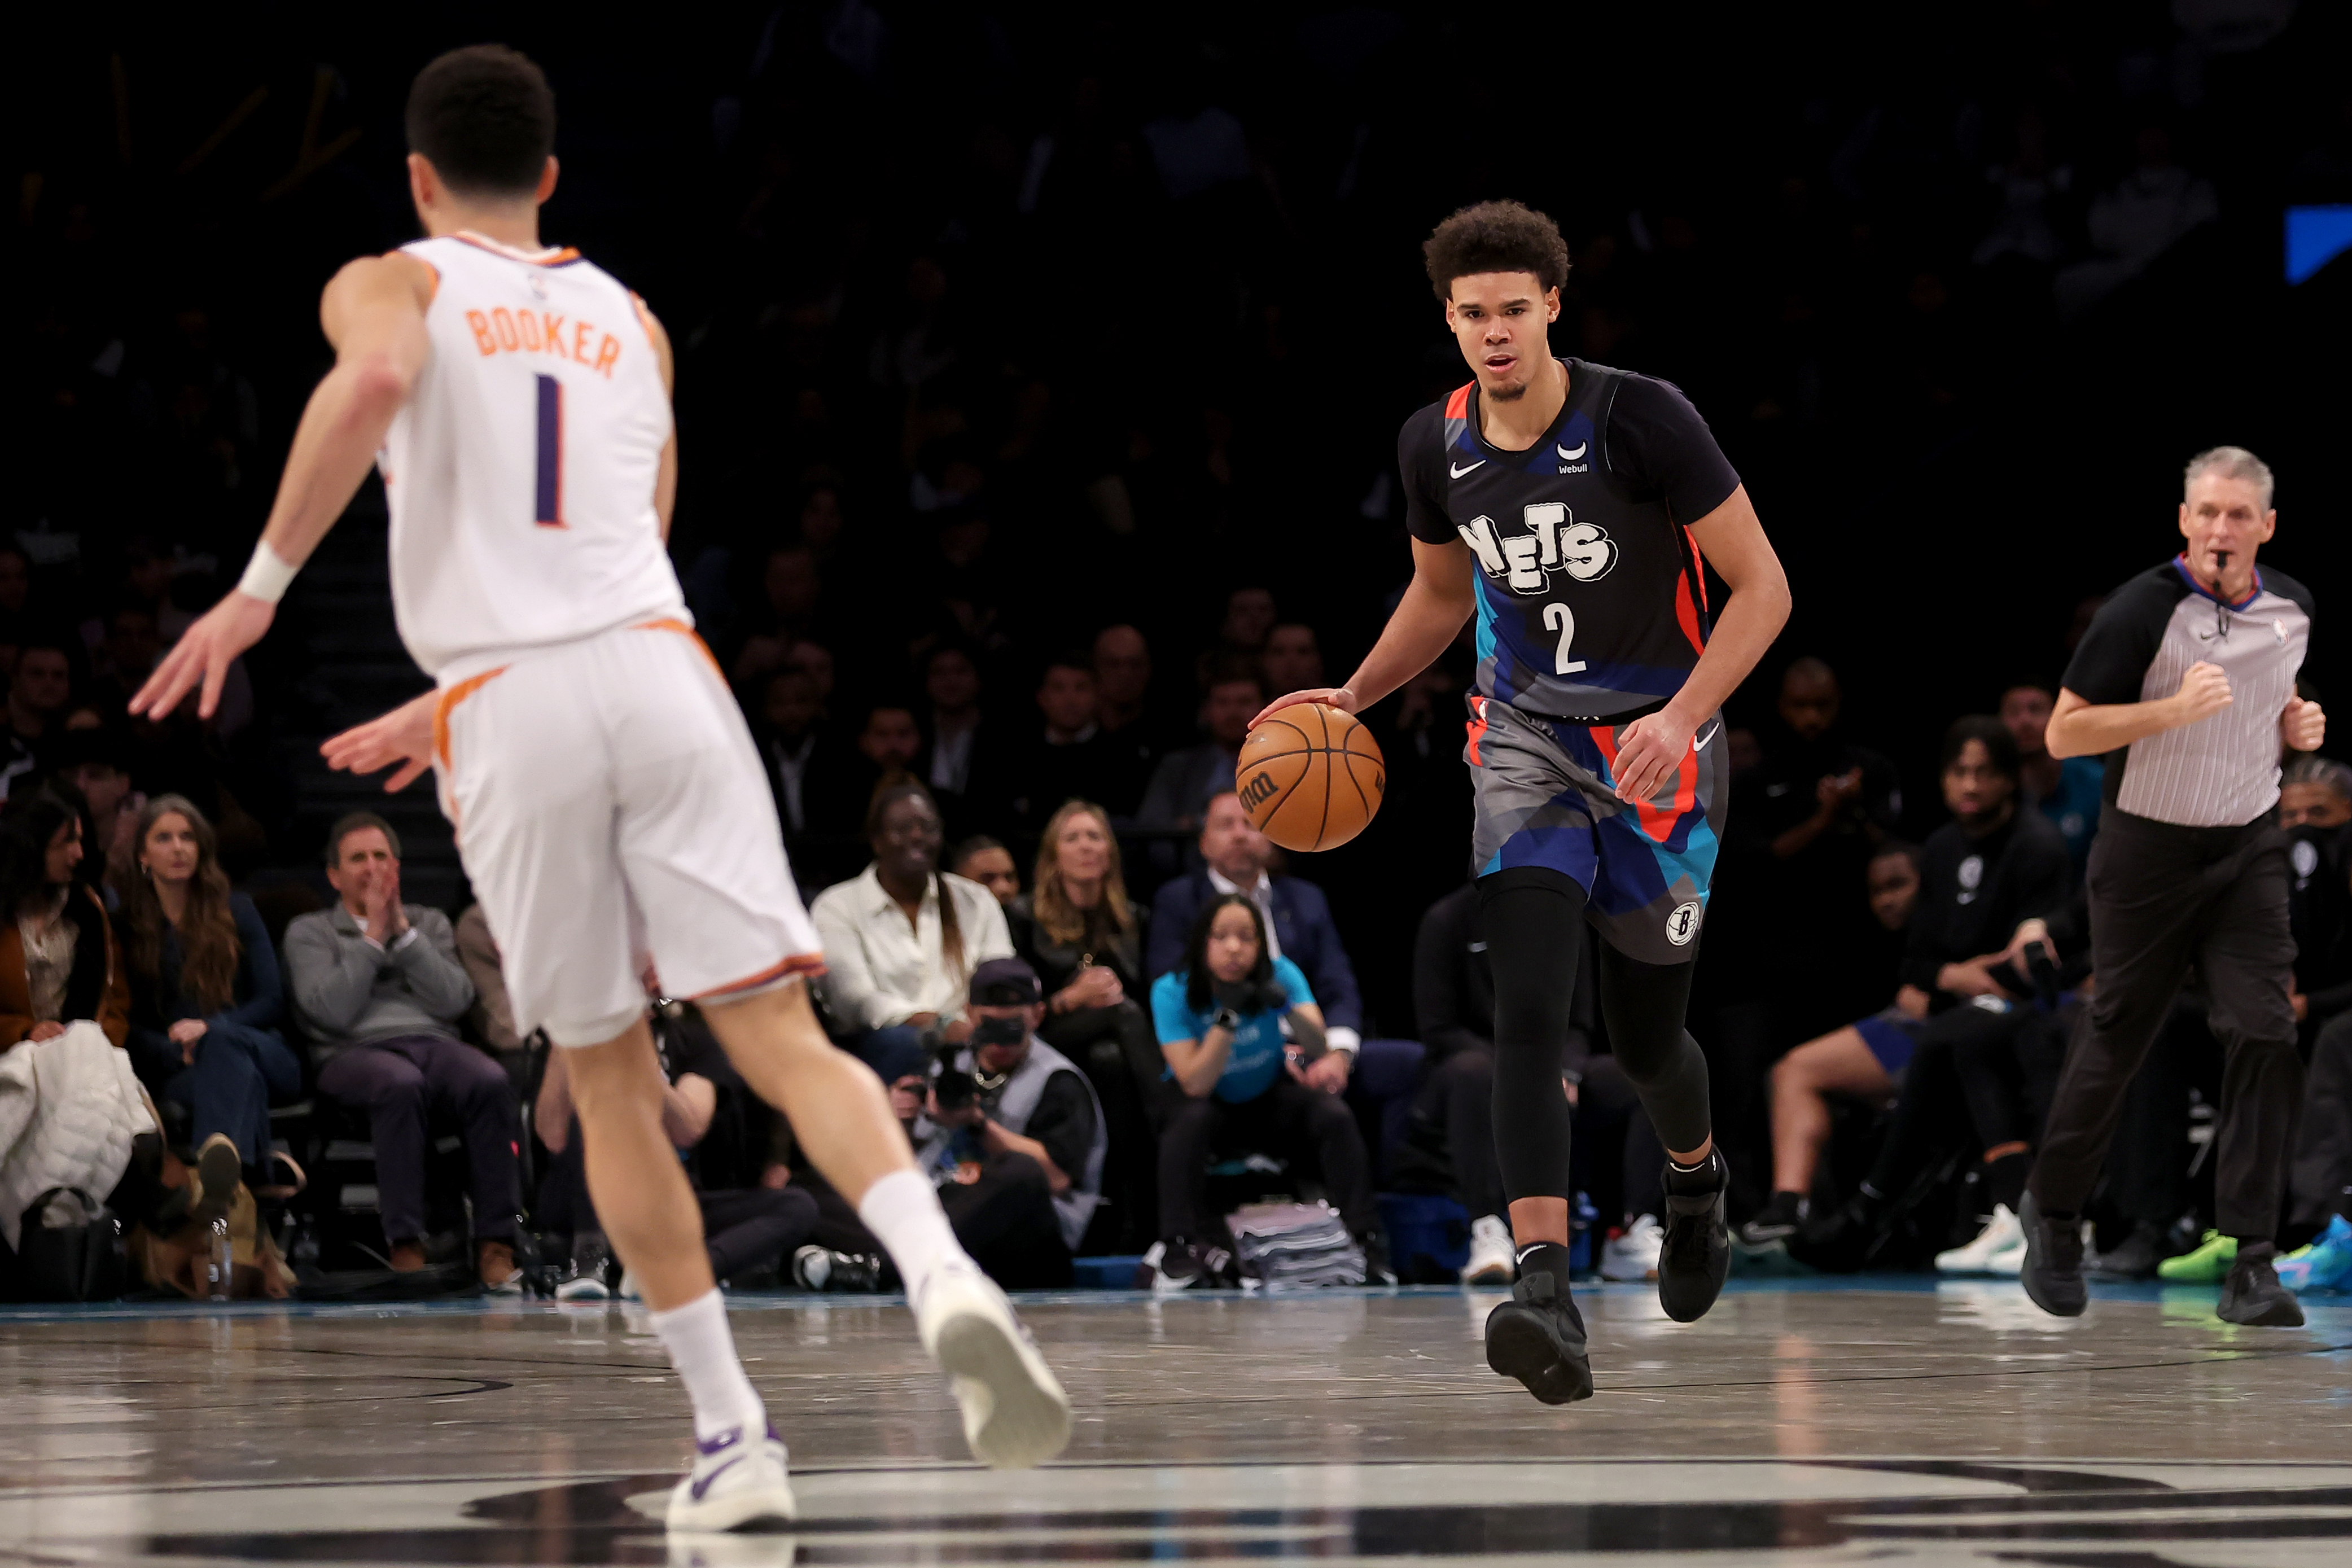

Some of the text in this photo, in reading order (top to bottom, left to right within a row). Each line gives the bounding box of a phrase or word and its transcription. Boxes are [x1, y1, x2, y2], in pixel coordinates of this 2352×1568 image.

[465, 307, 620, 379] BOOKER
[534, 373, 568, 529] 1
[1558, 463, 1587, 474] Webull
[1457, 502, 1618, 594] NETS
[1543, 602, 1587, 675] 2
[1678, 909, 1692, 936] B
